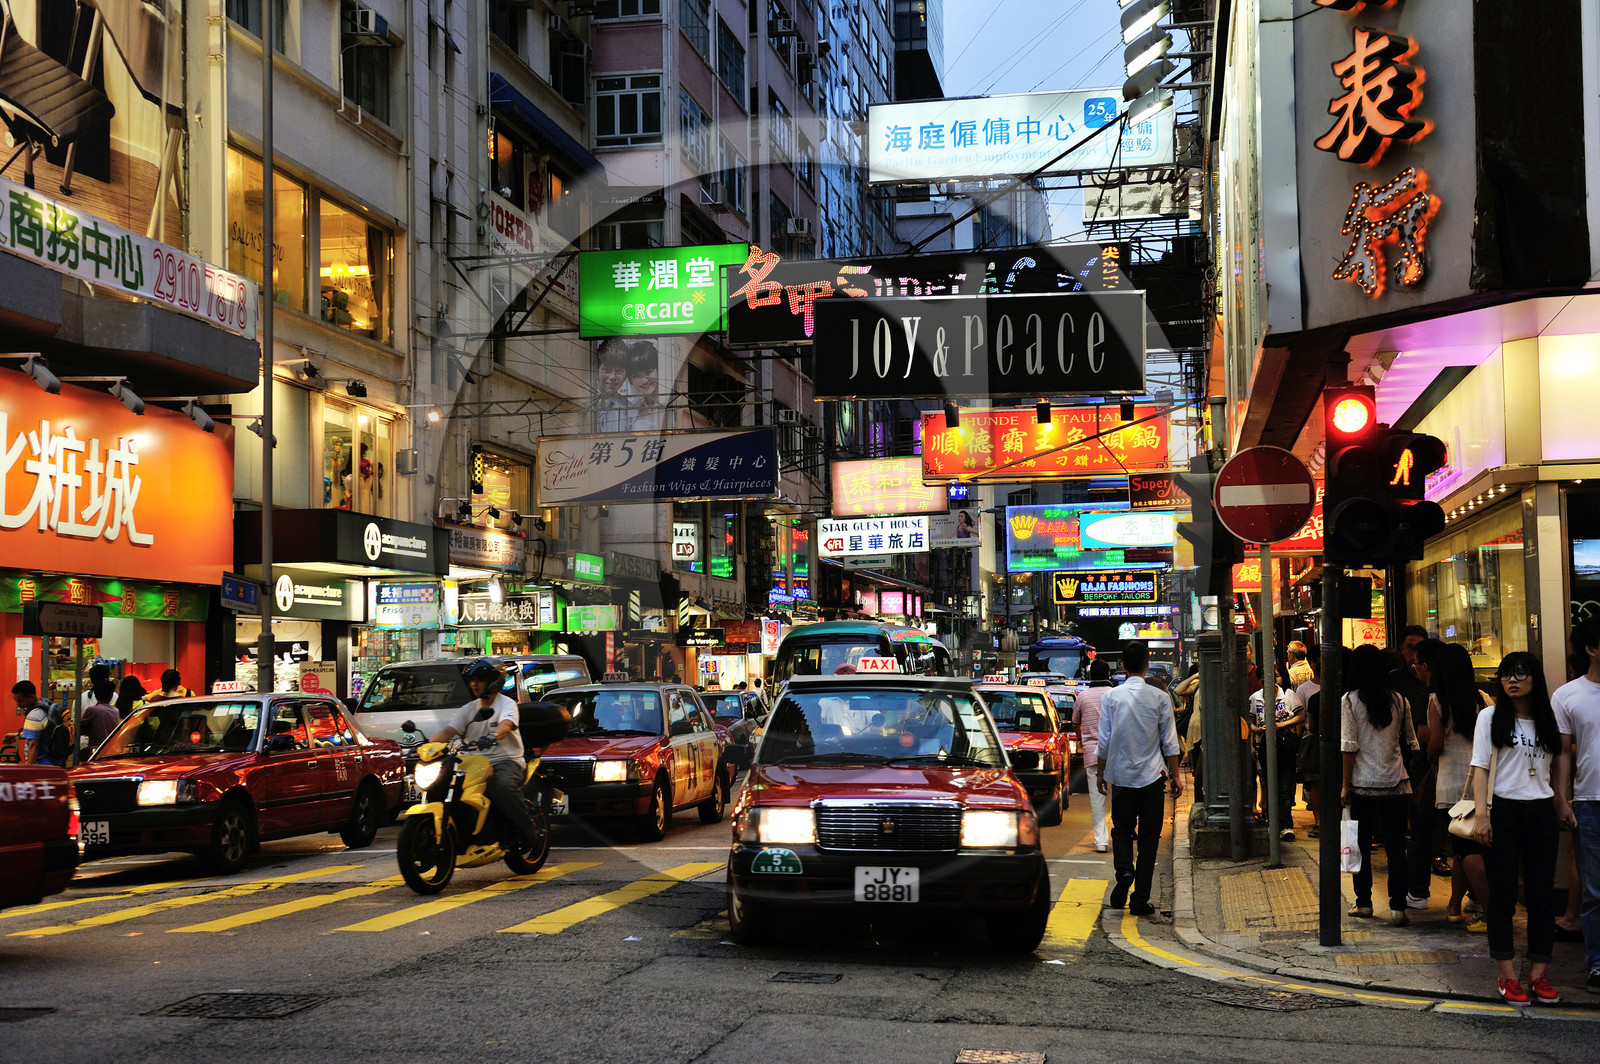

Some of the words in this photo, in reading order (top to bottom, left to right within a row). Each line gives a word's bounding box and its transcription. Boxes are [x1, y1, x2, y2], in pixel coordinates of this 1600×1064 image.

[885, 115, 1076, 152] 海庭僱傭中心
[1313, 0, 1431, 295] 表行
[885, 157, 924, 168] Pacific
[927, 154, 972, 166] Garden
[976, 150, 1051, 163] Employment
[9, 190, 143, 290] 商務中心
[612, 257, 715, 291] 華潤堂
[153, 249, 200, 312] 2910
[204, 269, 248, 330] 7878
[621, 301, 694, 321] CRcare
[933, 326, 949, 377] &
[588, 438, 667, 468] 第5街
[556, 454, 585, 475] Fifth
[621, 480, 665, 493] Fashion
[668, 479, 697, 494] Wigs
[712, 477, 772, 492] Hairpieces
[849, 473, 930, 496] 恭和堂
[1132, 477, 1168, 491] Super
[822, 523, 848, 533] STAR
[853, 521, 884, 531] GUEST
[890, 519, 923, 530] HOUSE
[1037, 521, 1069, 534] RAJA
[382, 533, 427, 550] acupuncture
[849, 533, 923, 551] 星華旅店
[294, 584, 342, 598] acupuncture
[1081, 582, 1106, 591] RAJA
[1107, 581, 1154, 591] FASHIONS
[1121, 592, 1151, 600] TAILORS
[382, 606, 404, 614] Friso
[861, 659, 895, 670] TAXI
[605, 673, 626, 681] TAXI
[215, 682, 239, 691] TAXI
[81, 822, 98, 833] KJ
[772, 854, 782, 866] 5
[873, 868, 902, 885] JY
[863, 884, 912, 902] 8881
